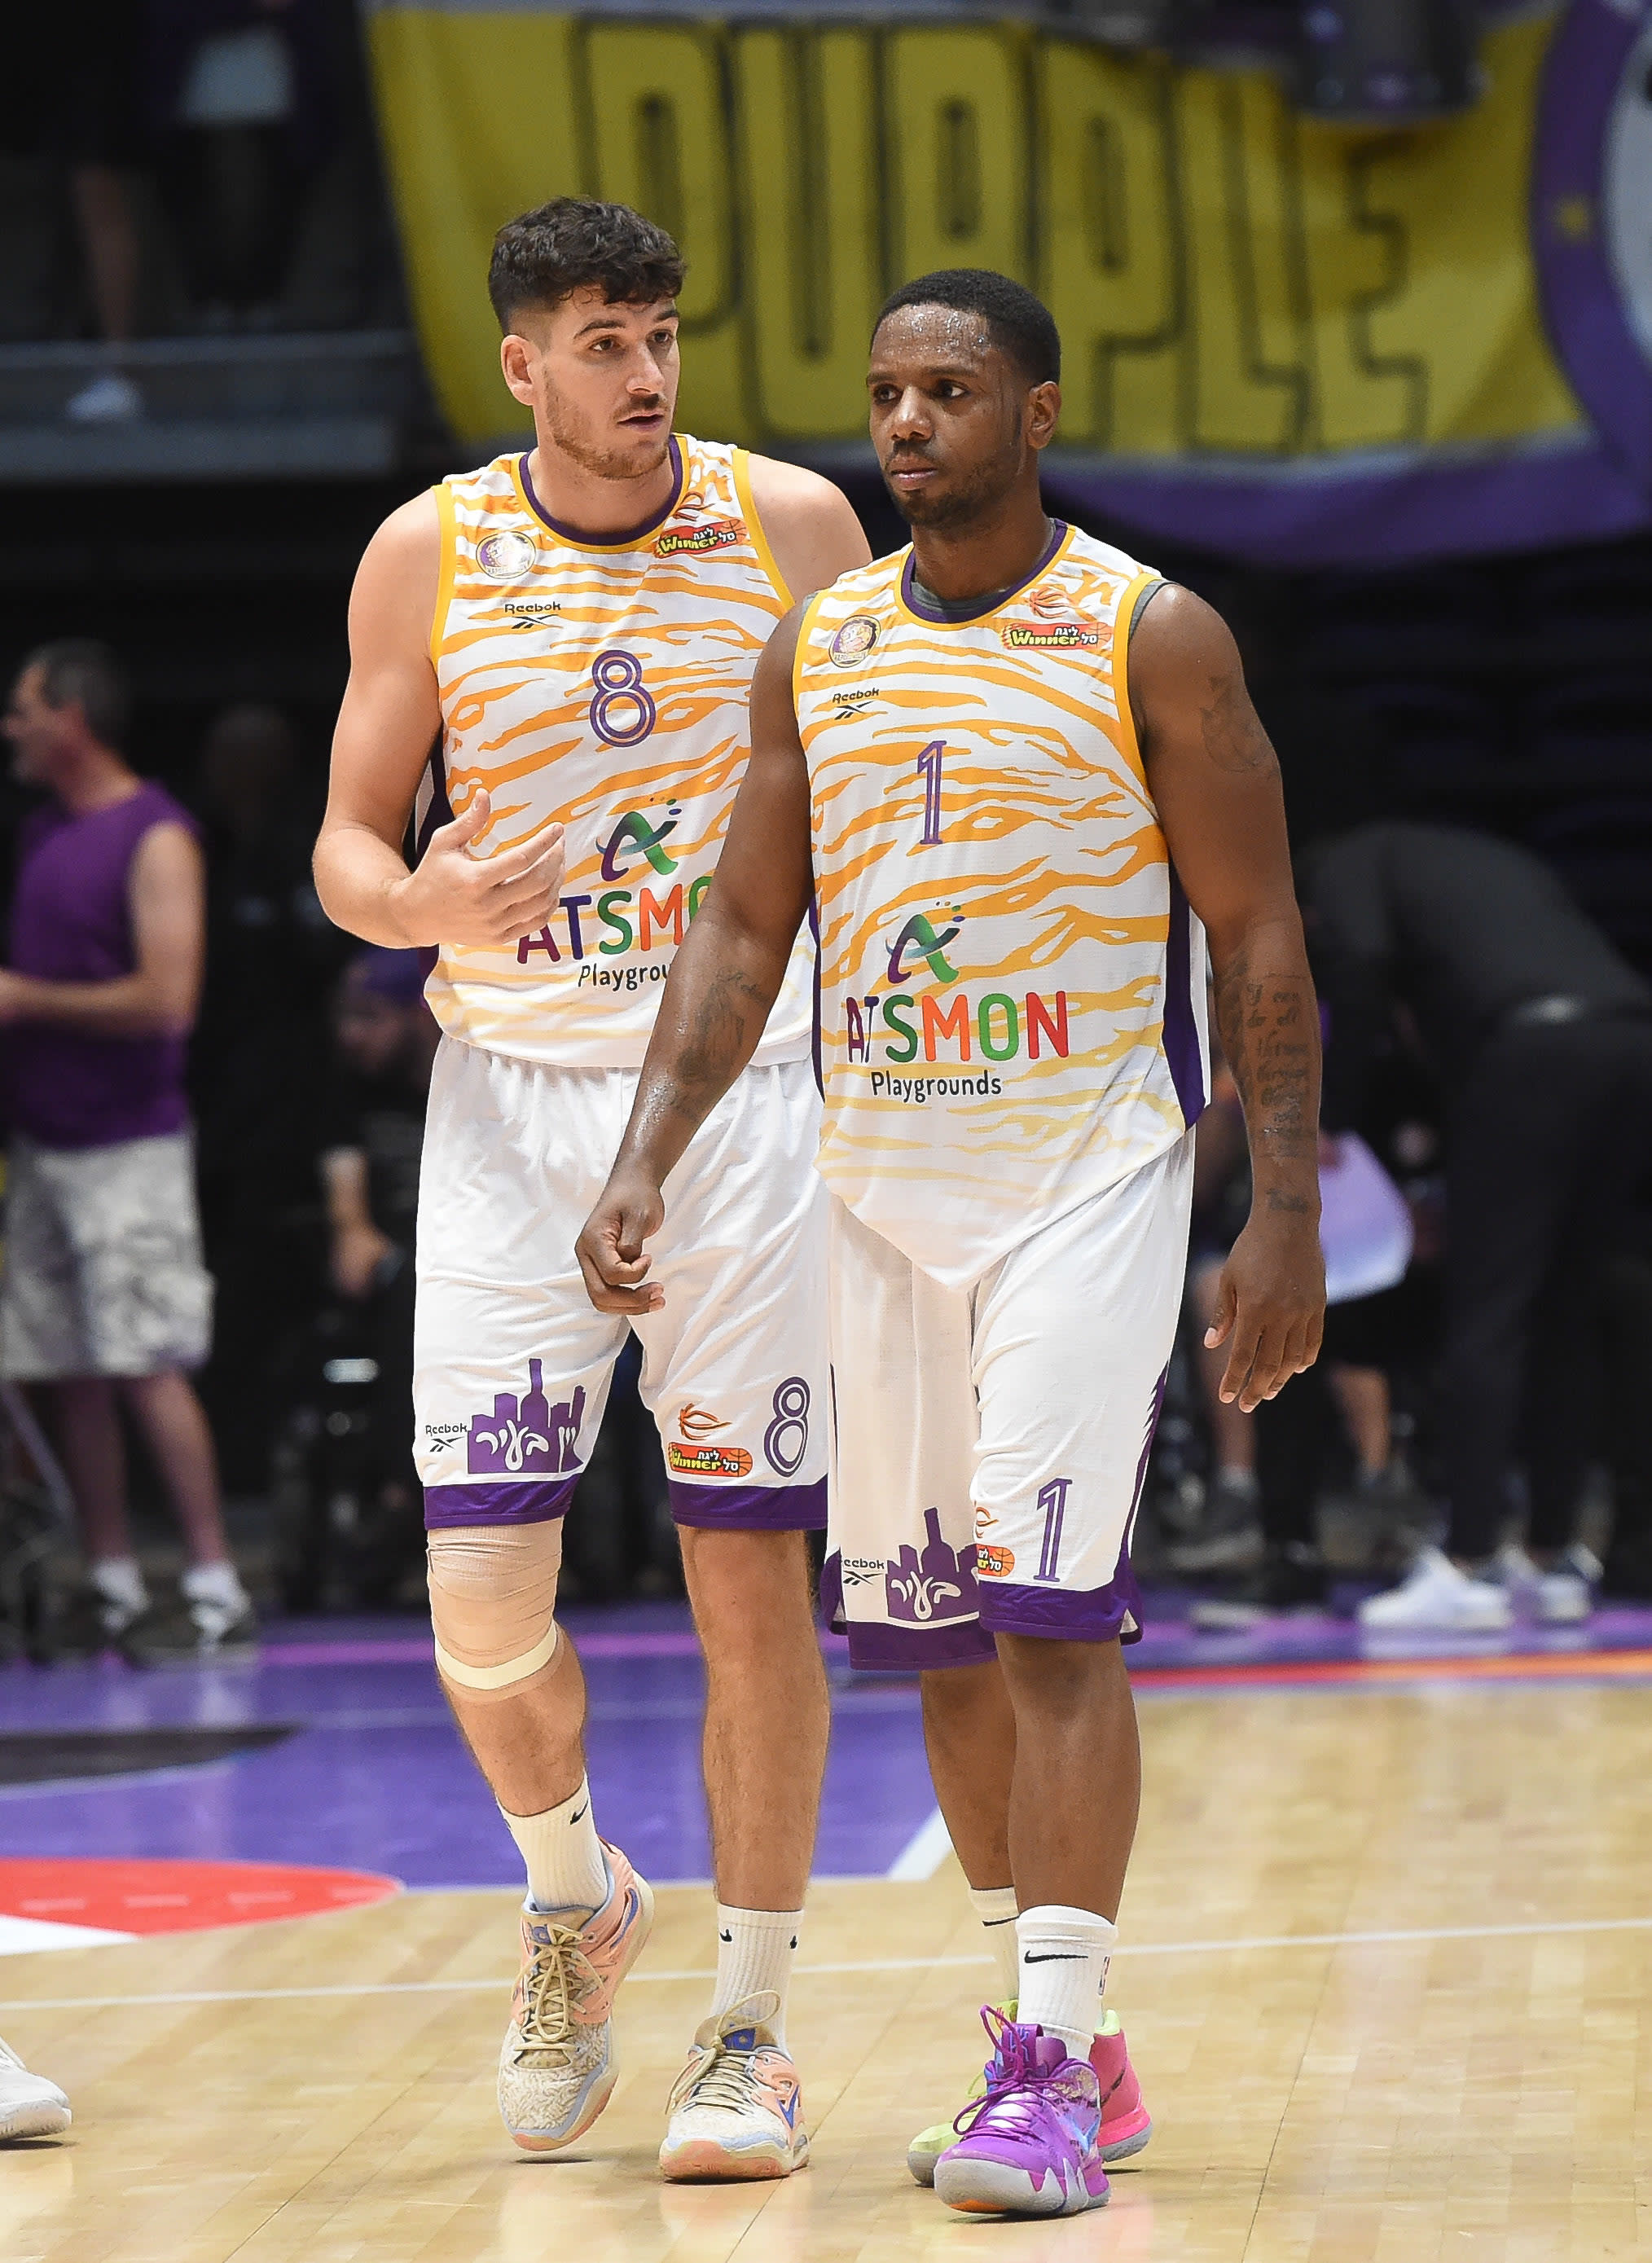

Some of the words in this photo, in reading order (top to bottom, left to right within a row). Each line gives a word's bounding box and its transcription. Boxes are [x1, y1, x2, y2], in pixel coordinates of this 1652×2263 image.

[504, 601, 561, 614] Reebok
[1011, 630, 1079, 646] Winner
[590, 649, 657, 748] 8
[832, 688, 880, 704] Reebok
[917, 740, 947, 845] 1
[846, 991, 1069, 1063] ATSMON
[871, 1070, 1002, 1104] Playgrounds
[425, 1423, 468, 1436] Reebok
[763, 1376, 811, 1478] 8
[1034, 1478, 1073, 1583] 1
[841, 1558, 885, 1570] eebok
